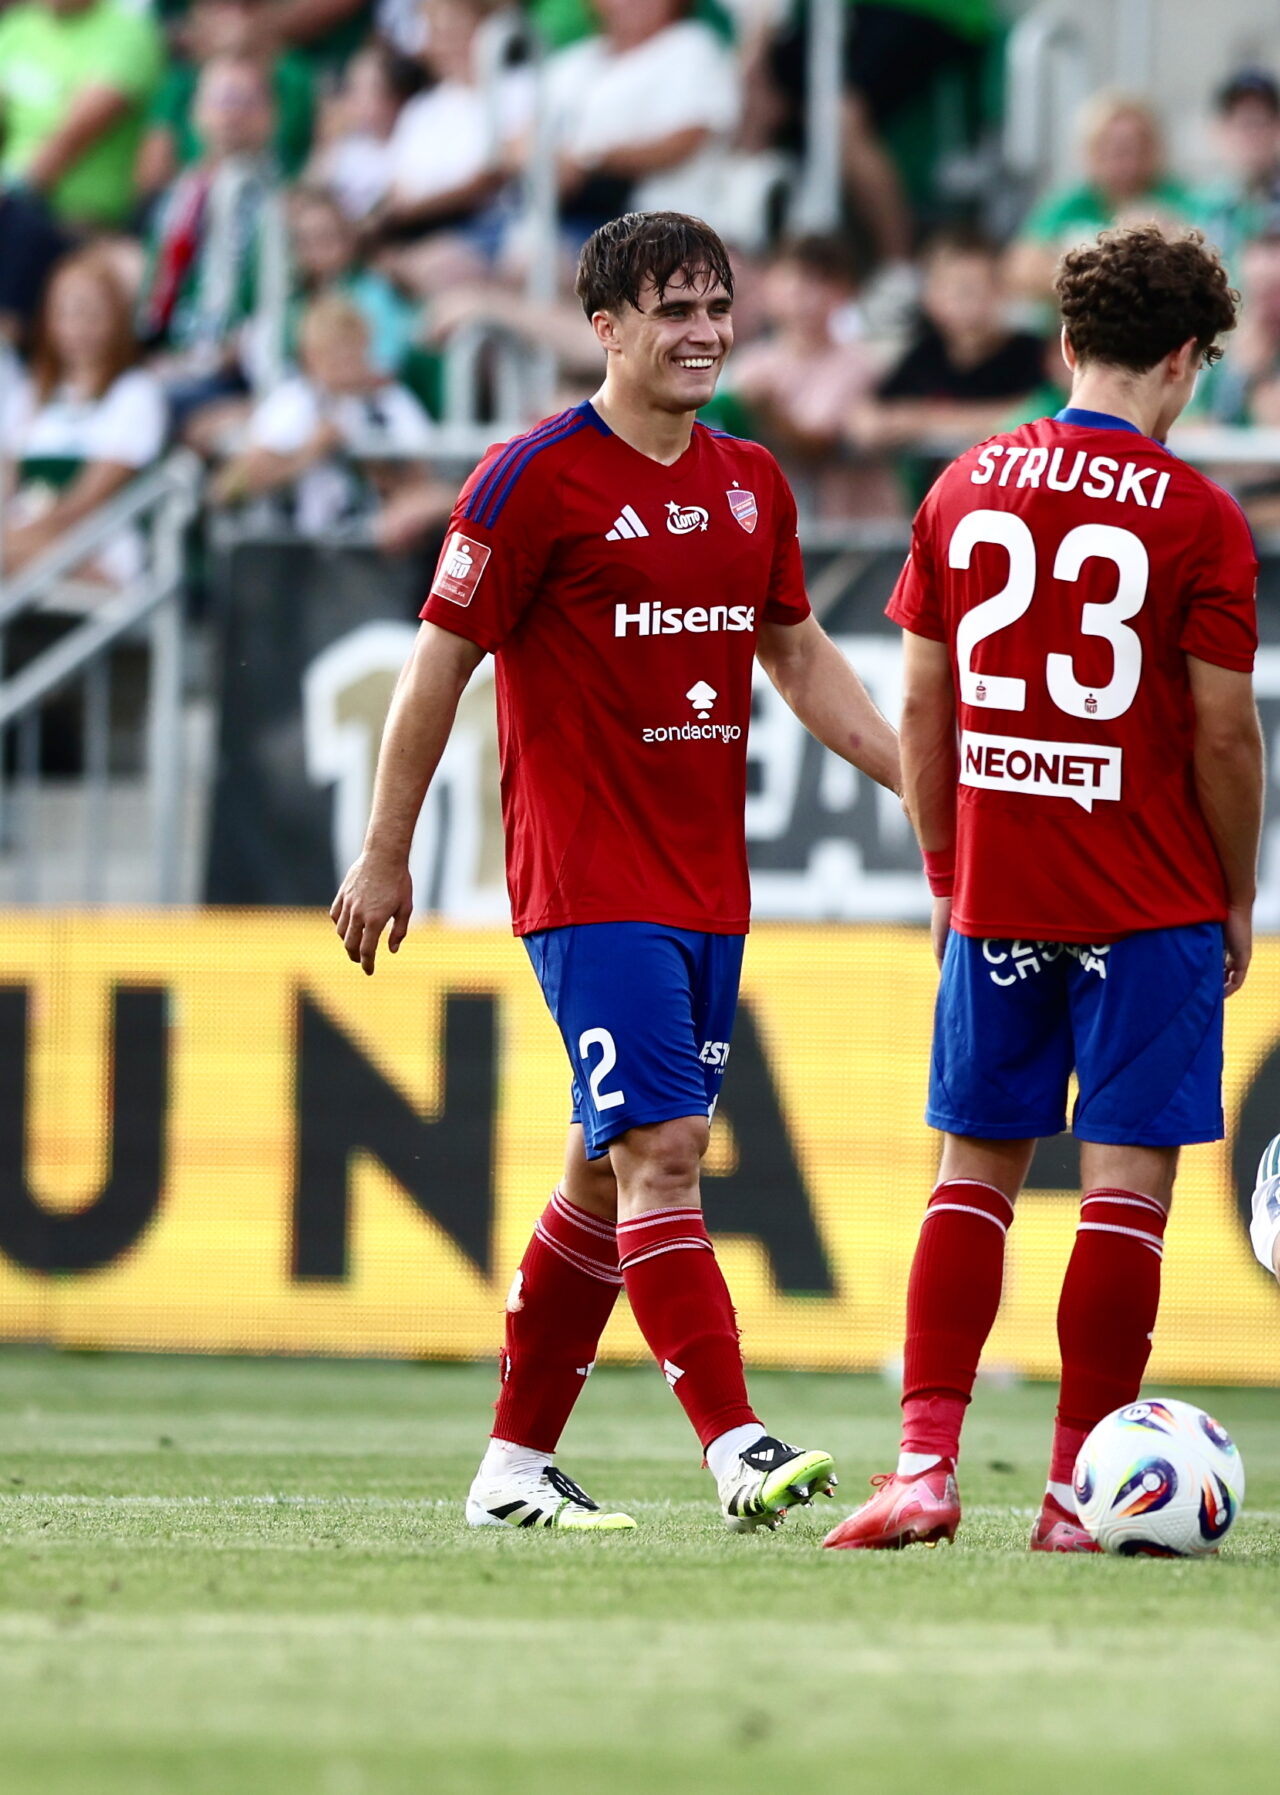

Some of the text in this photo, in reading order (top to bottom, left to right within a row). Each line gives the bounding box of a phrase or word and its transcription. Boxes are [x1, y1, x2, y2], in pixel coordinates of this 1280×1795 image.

[970, 444, 1171, 509] STRUSKI
[615, 600, 754, 637] Hisense
[948, 508, 1149, 721] 23
[966, 743, 1110, 787] NEONET
[578, 1027, 625, 1113] 2
